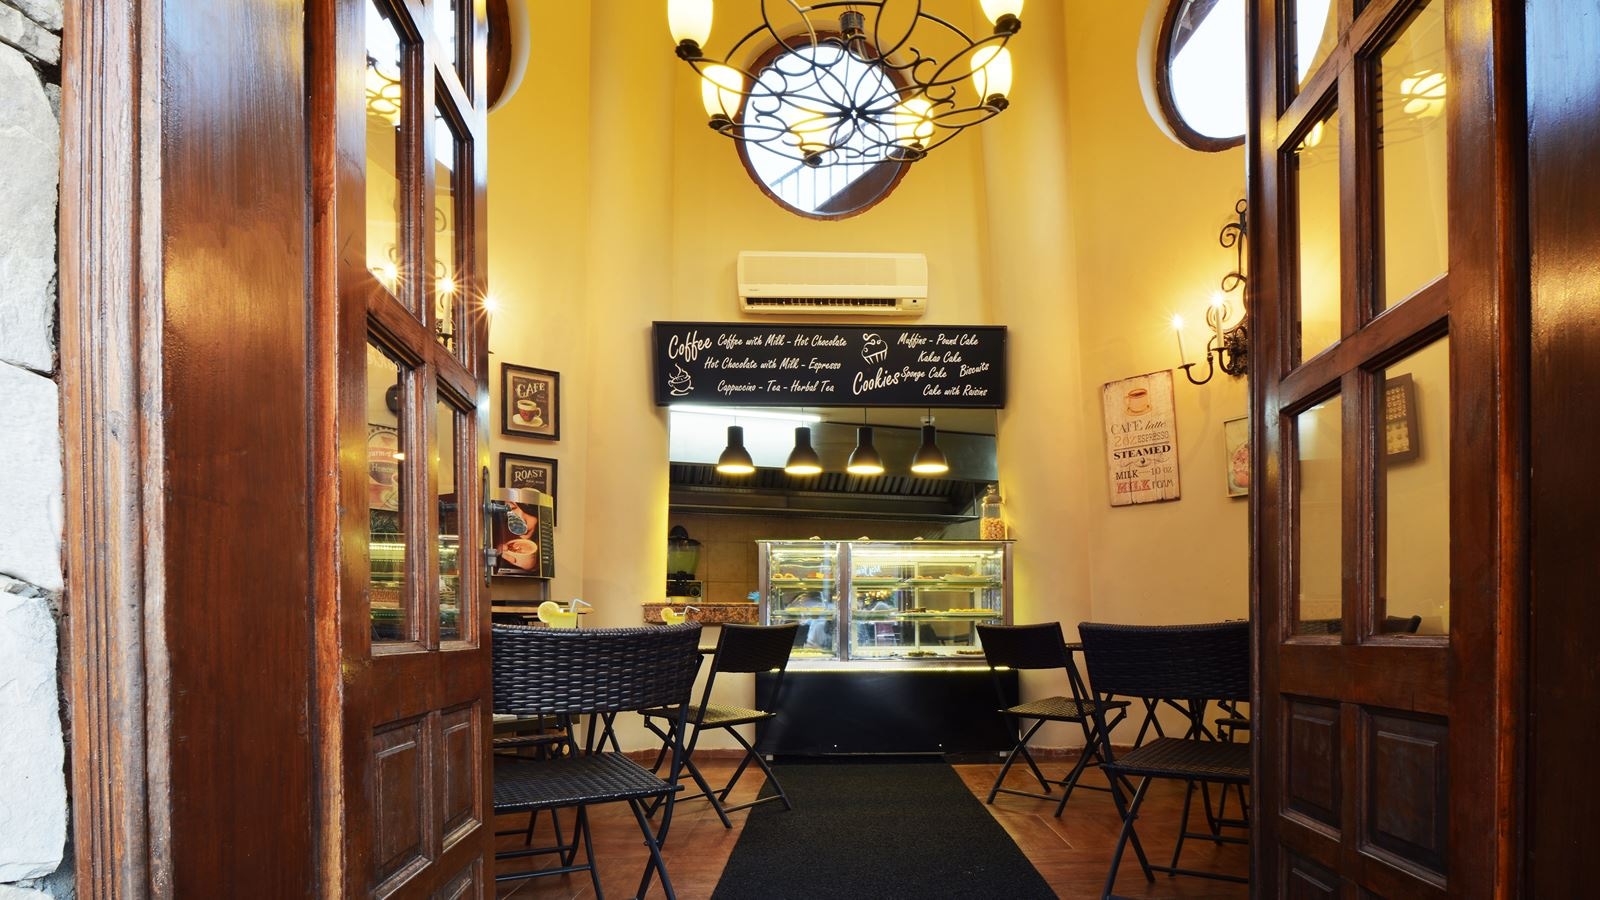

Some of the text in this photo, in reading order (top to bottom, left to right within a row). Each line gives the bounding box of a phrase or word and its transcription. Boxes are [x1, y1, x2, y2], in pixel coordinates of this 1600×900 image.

[668, 330, 712, 362] Coffee
[718, 334, 743, 349] Coffee
[746, 335, 762, 345] with
[765, 334, 785, 346] Milk
[794, 334, 809, 346] Hot
[811, 335, 847, 346] Chocolate
[897, 333, 927, 348] Muffins
[936, 334, 958, 345] Pound
[960, 334, 978, 345] Cake
[918, 351, 961, 363] Kakao Cake
[704, 357, 719, 368] Hot
[722, 357, 757, 369] Chocolate
[761, 359, 776, 368] with
[779, 358, 799, 369] Milk
[809, 358, 841, 373] Espresso
[960, 362, 989, 377] Biscuits
[853, 367, 900, 395] Cookies
[901, 366, 947, 381] Sponge Cake
[718, 380, 756, 395] Cappuccino
[767, 380, 780, 391] Tea
[791, 380, 818, 391] Herbal
[818, 380, 834, 392] Tea
[923, 384, 987, 396] Cake with Raisins
[1145, 421, 1167, 430] latte
[1137, 431, 1169, 443] ESPRESSO
[1114, 445, 1170, 460] STEAMED
[515, 470, 544, 482] ROAST
[1115, 470, 1138, 480] MILK
[1151, 467, 1161, 475] 10
[1117, 480, 1174, 493] MILK FOAM
